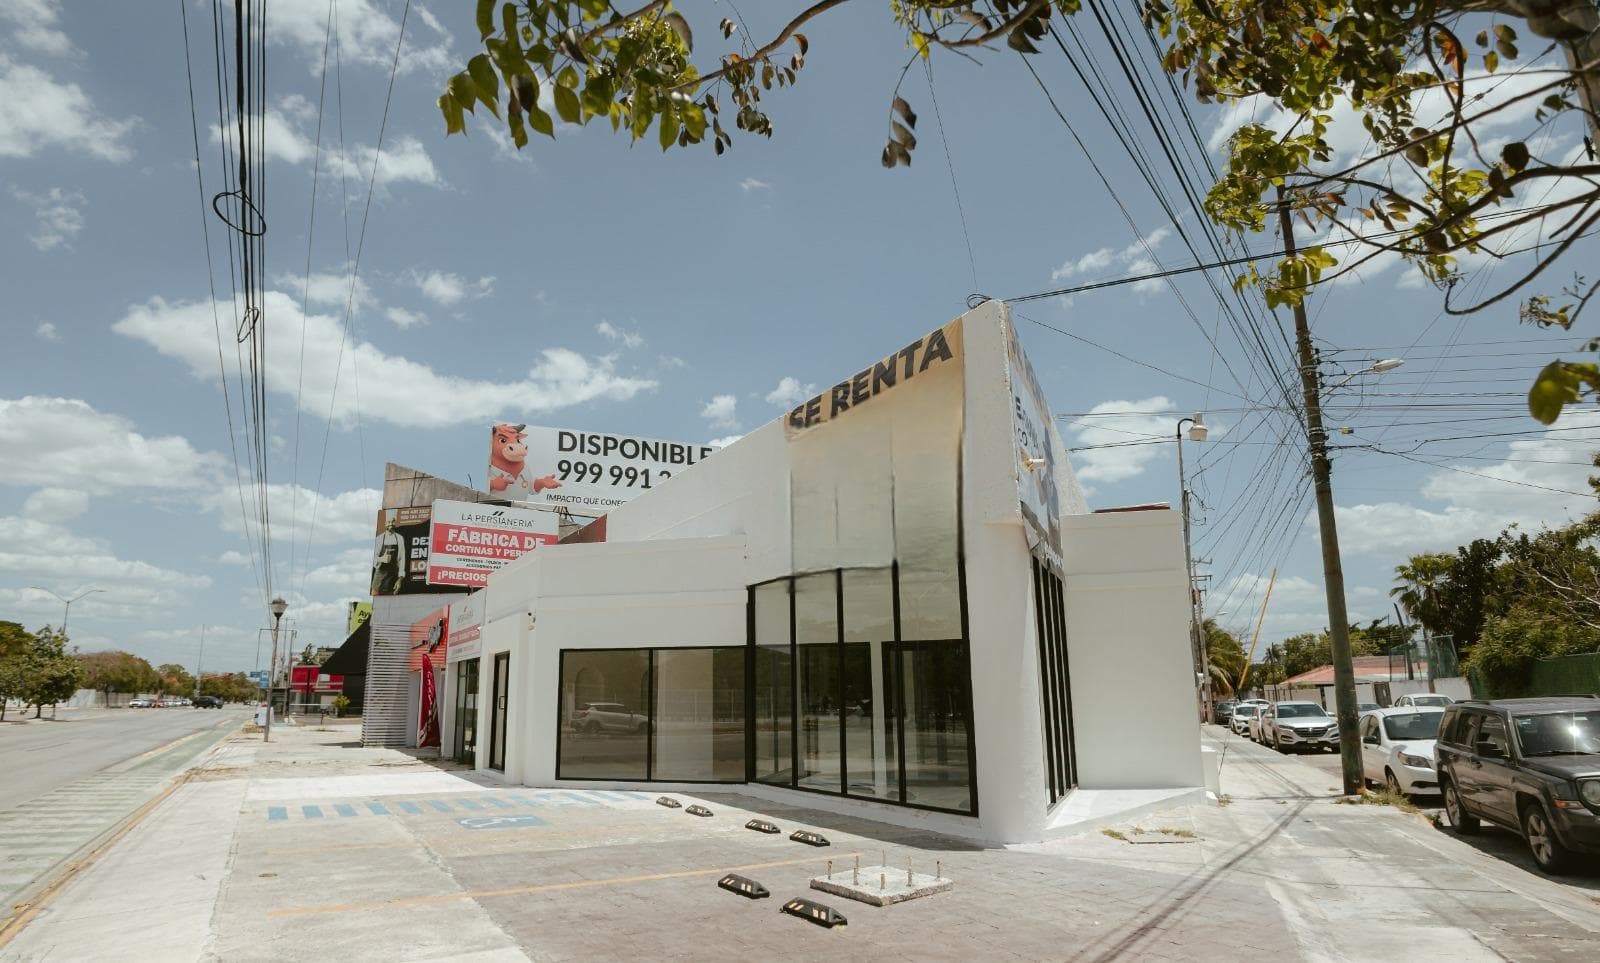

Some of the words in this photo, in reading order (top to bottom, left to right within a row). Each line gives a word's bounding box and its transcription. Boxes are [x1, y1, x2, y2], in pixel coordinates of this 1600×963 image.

[789, 394, 823, 429] SE
[831, 328, 953, 419] RENTA
[558, 431, 713, 465] DISPONIBLE
[557, 459, 603, 484] 999
[609, 465, 652, 489] 991
[546, 493, 582, 504] IMPACTO
[583, 497, 599, 505] QUE
[461, 513, 473, 521] LA
[448, 527, 519, 548] FÁBRICA
[524, 535, 546, 550] DE
[445, 543, 493, 556] CORTINAS
[495, 547, 502, 556] Y
[437, 570, 487, 583] ¡PRECIOS
